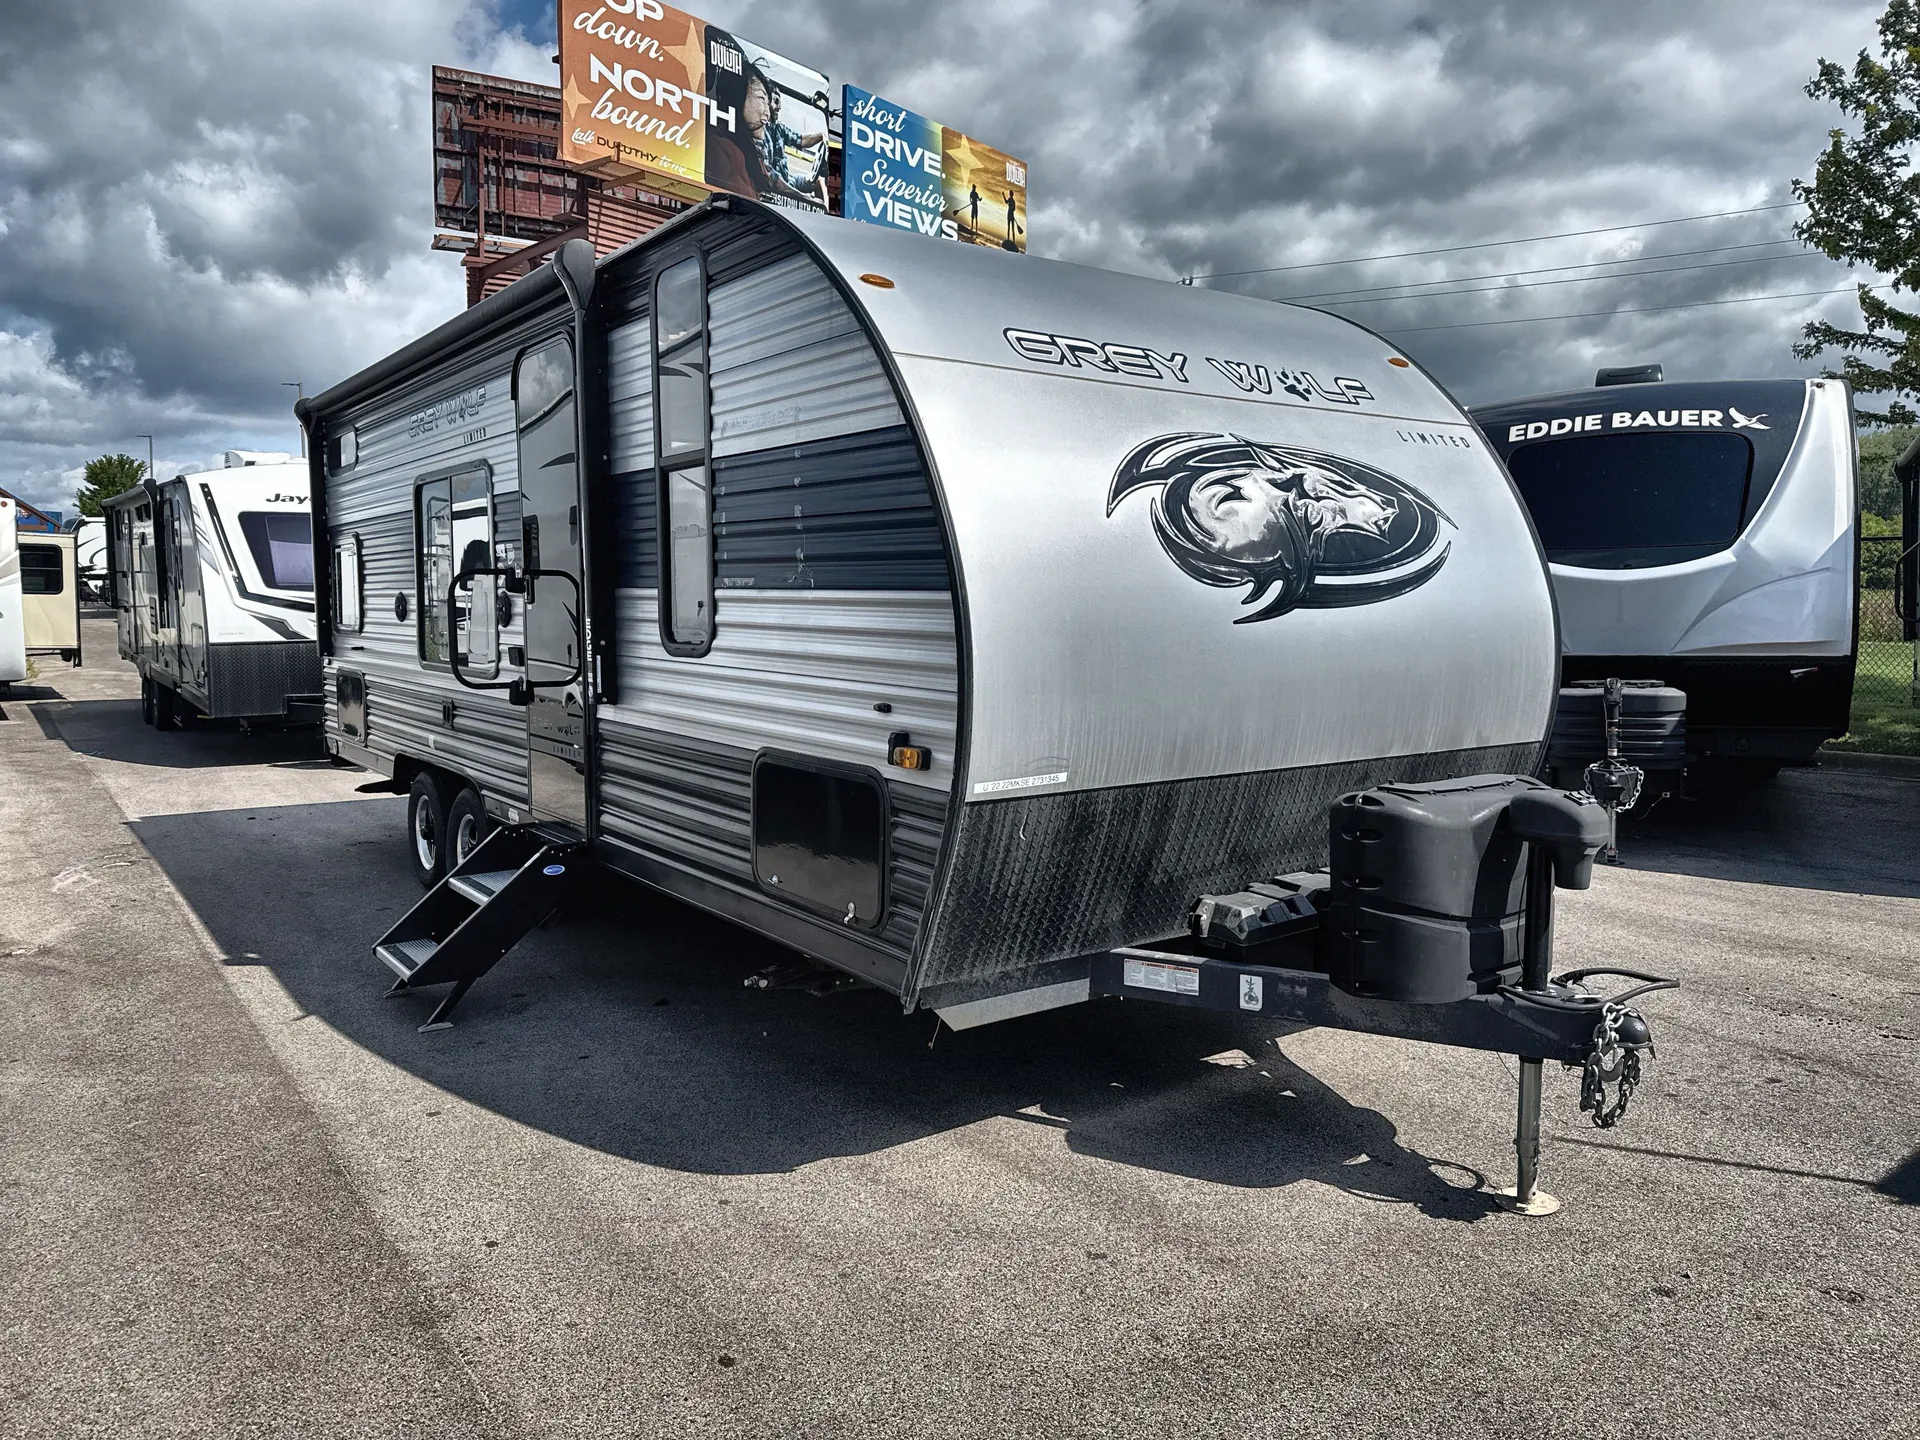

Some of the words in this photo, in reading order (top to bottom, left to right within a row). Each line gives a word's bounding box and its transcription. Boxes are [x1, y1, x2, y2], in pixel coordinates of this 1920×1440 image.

[573, 6, 664, 62] down.
[710, 40, 743, 76] DULUTH
[590, 52, 736, 133] NORTH
[852, 94, 907, 133] short
[571, 127, 595, 146] talk
[590, 87, 694, 149] bound.
[851, 120, 946, 179] DRIVE.
[861, 158, 949, 212] Superior
[1002, 327, 1190, 383] GREY
[1396, 430, 1471, 448] LIMITED
[1508, 413, 1603, 443] EDDIE
[1611, 409, 1724, 428] BAUER
[265, 493, 311, 505] Jay
